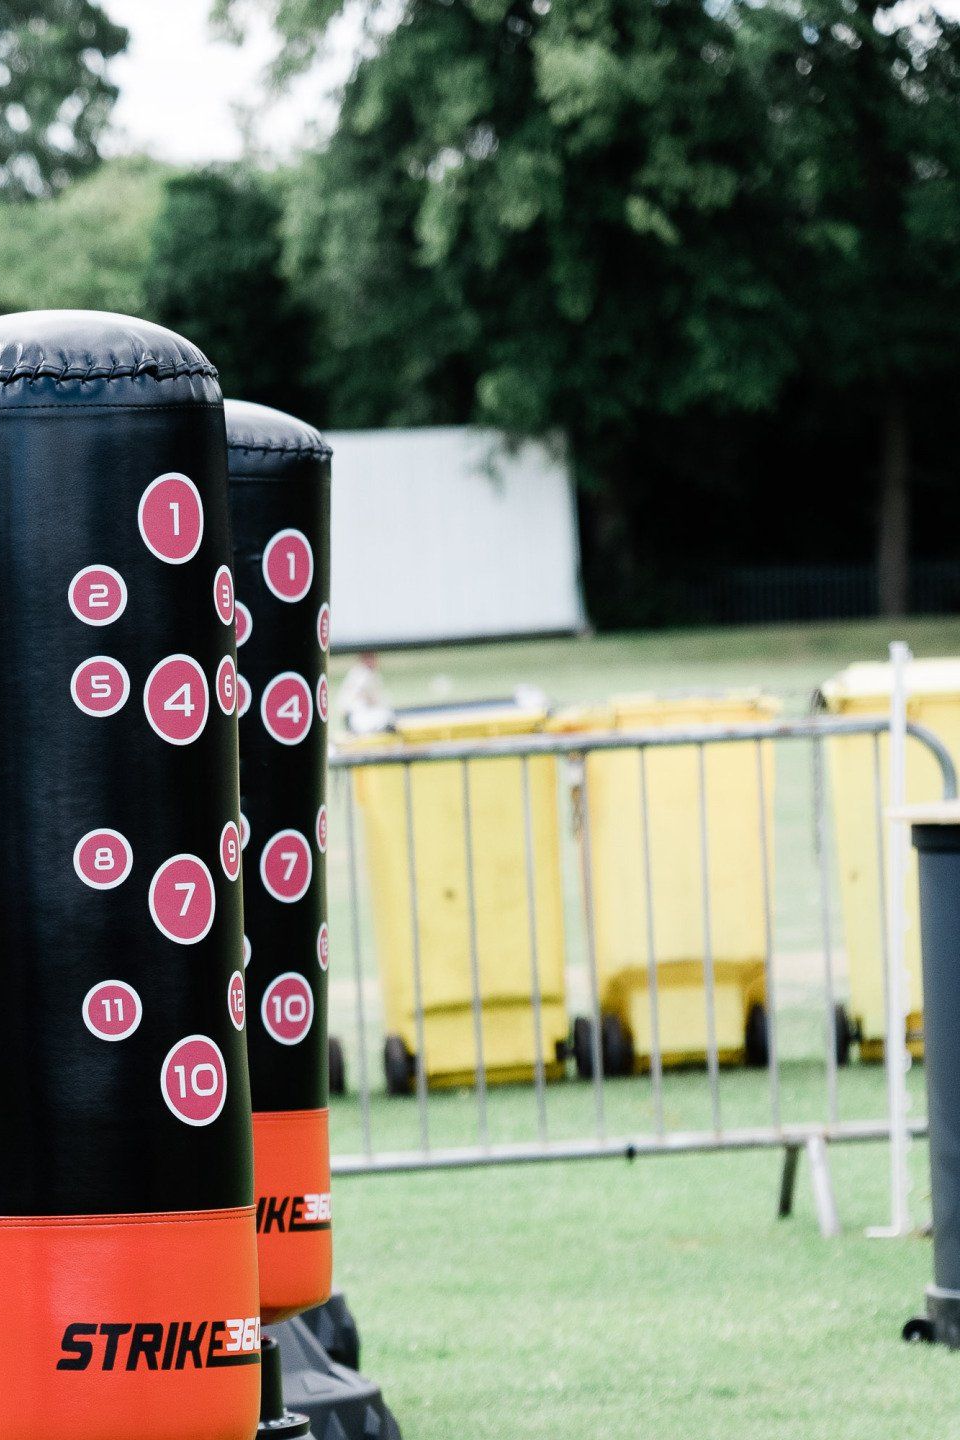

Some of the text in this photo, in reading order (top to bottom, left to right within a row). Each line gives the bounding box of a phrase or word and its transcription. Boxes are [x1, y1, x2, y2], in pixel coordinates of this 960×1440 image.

[169, 502, 180, 535] 1
[286, 552, 296, 580] 1
[89, 584, 109, 607] 2
[222, 585, 230, 607] 3
[90, 675, 111, 698] 5
[224, 675, 232, 697] 6
[164, 683, 194, 717] 4
[276, 695, 302, 723] 4
[94, 848, 114, 870] 8
[228, 840, 236, 862] 9
[281, 852, 298, 881] 7
[174, 882, 196, 916] 7
[101, 998, 125, 1022] 11
[233, 990, 244, 1012] 12
[272, 995, 307, 1023] 10
[174, 1063, 218, 1098] 10
